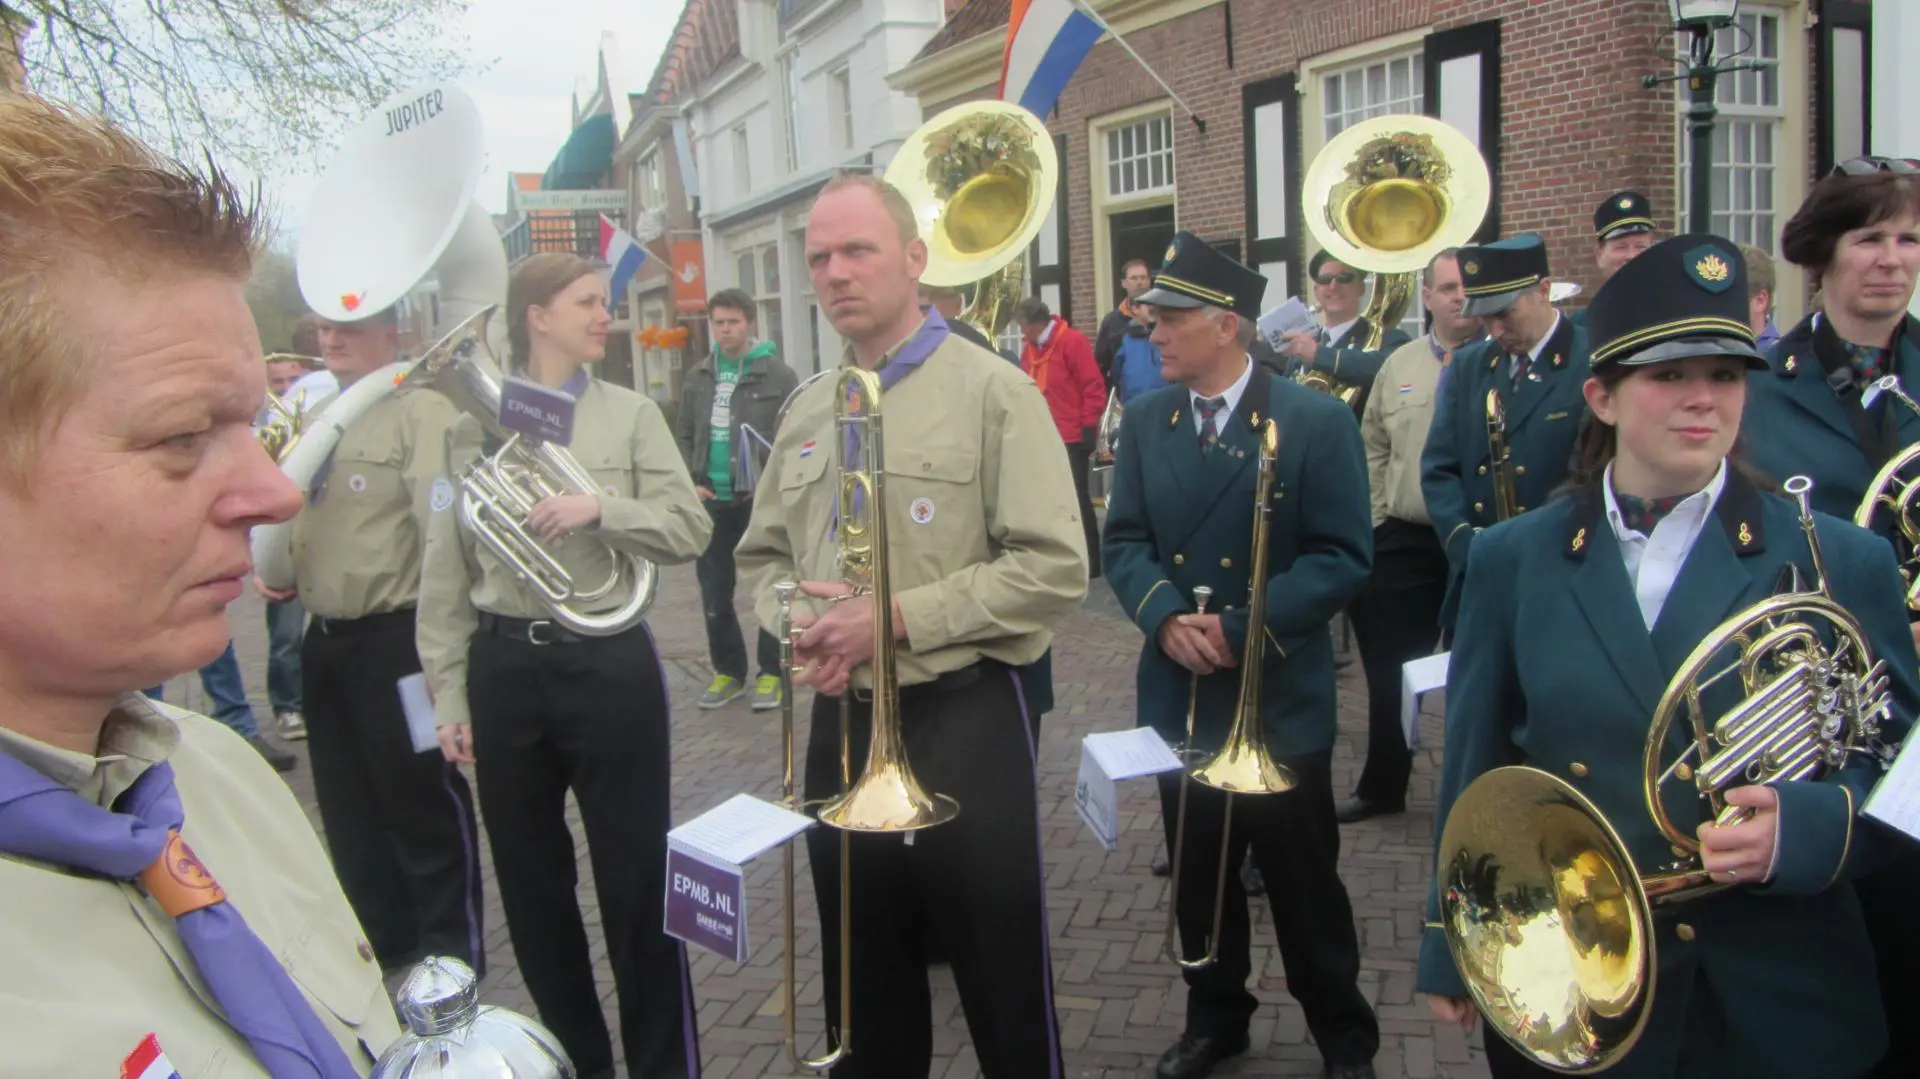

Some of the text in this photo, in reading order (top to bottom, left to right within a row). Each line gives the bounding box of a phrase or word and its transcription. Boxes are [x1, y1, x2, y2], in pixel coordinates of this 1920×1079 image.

[385, 88, 444, 136] JUPITER
[507, 399, 564, 428] EPMB.NL
[673, 872, 736, 917] EPMB.NL
